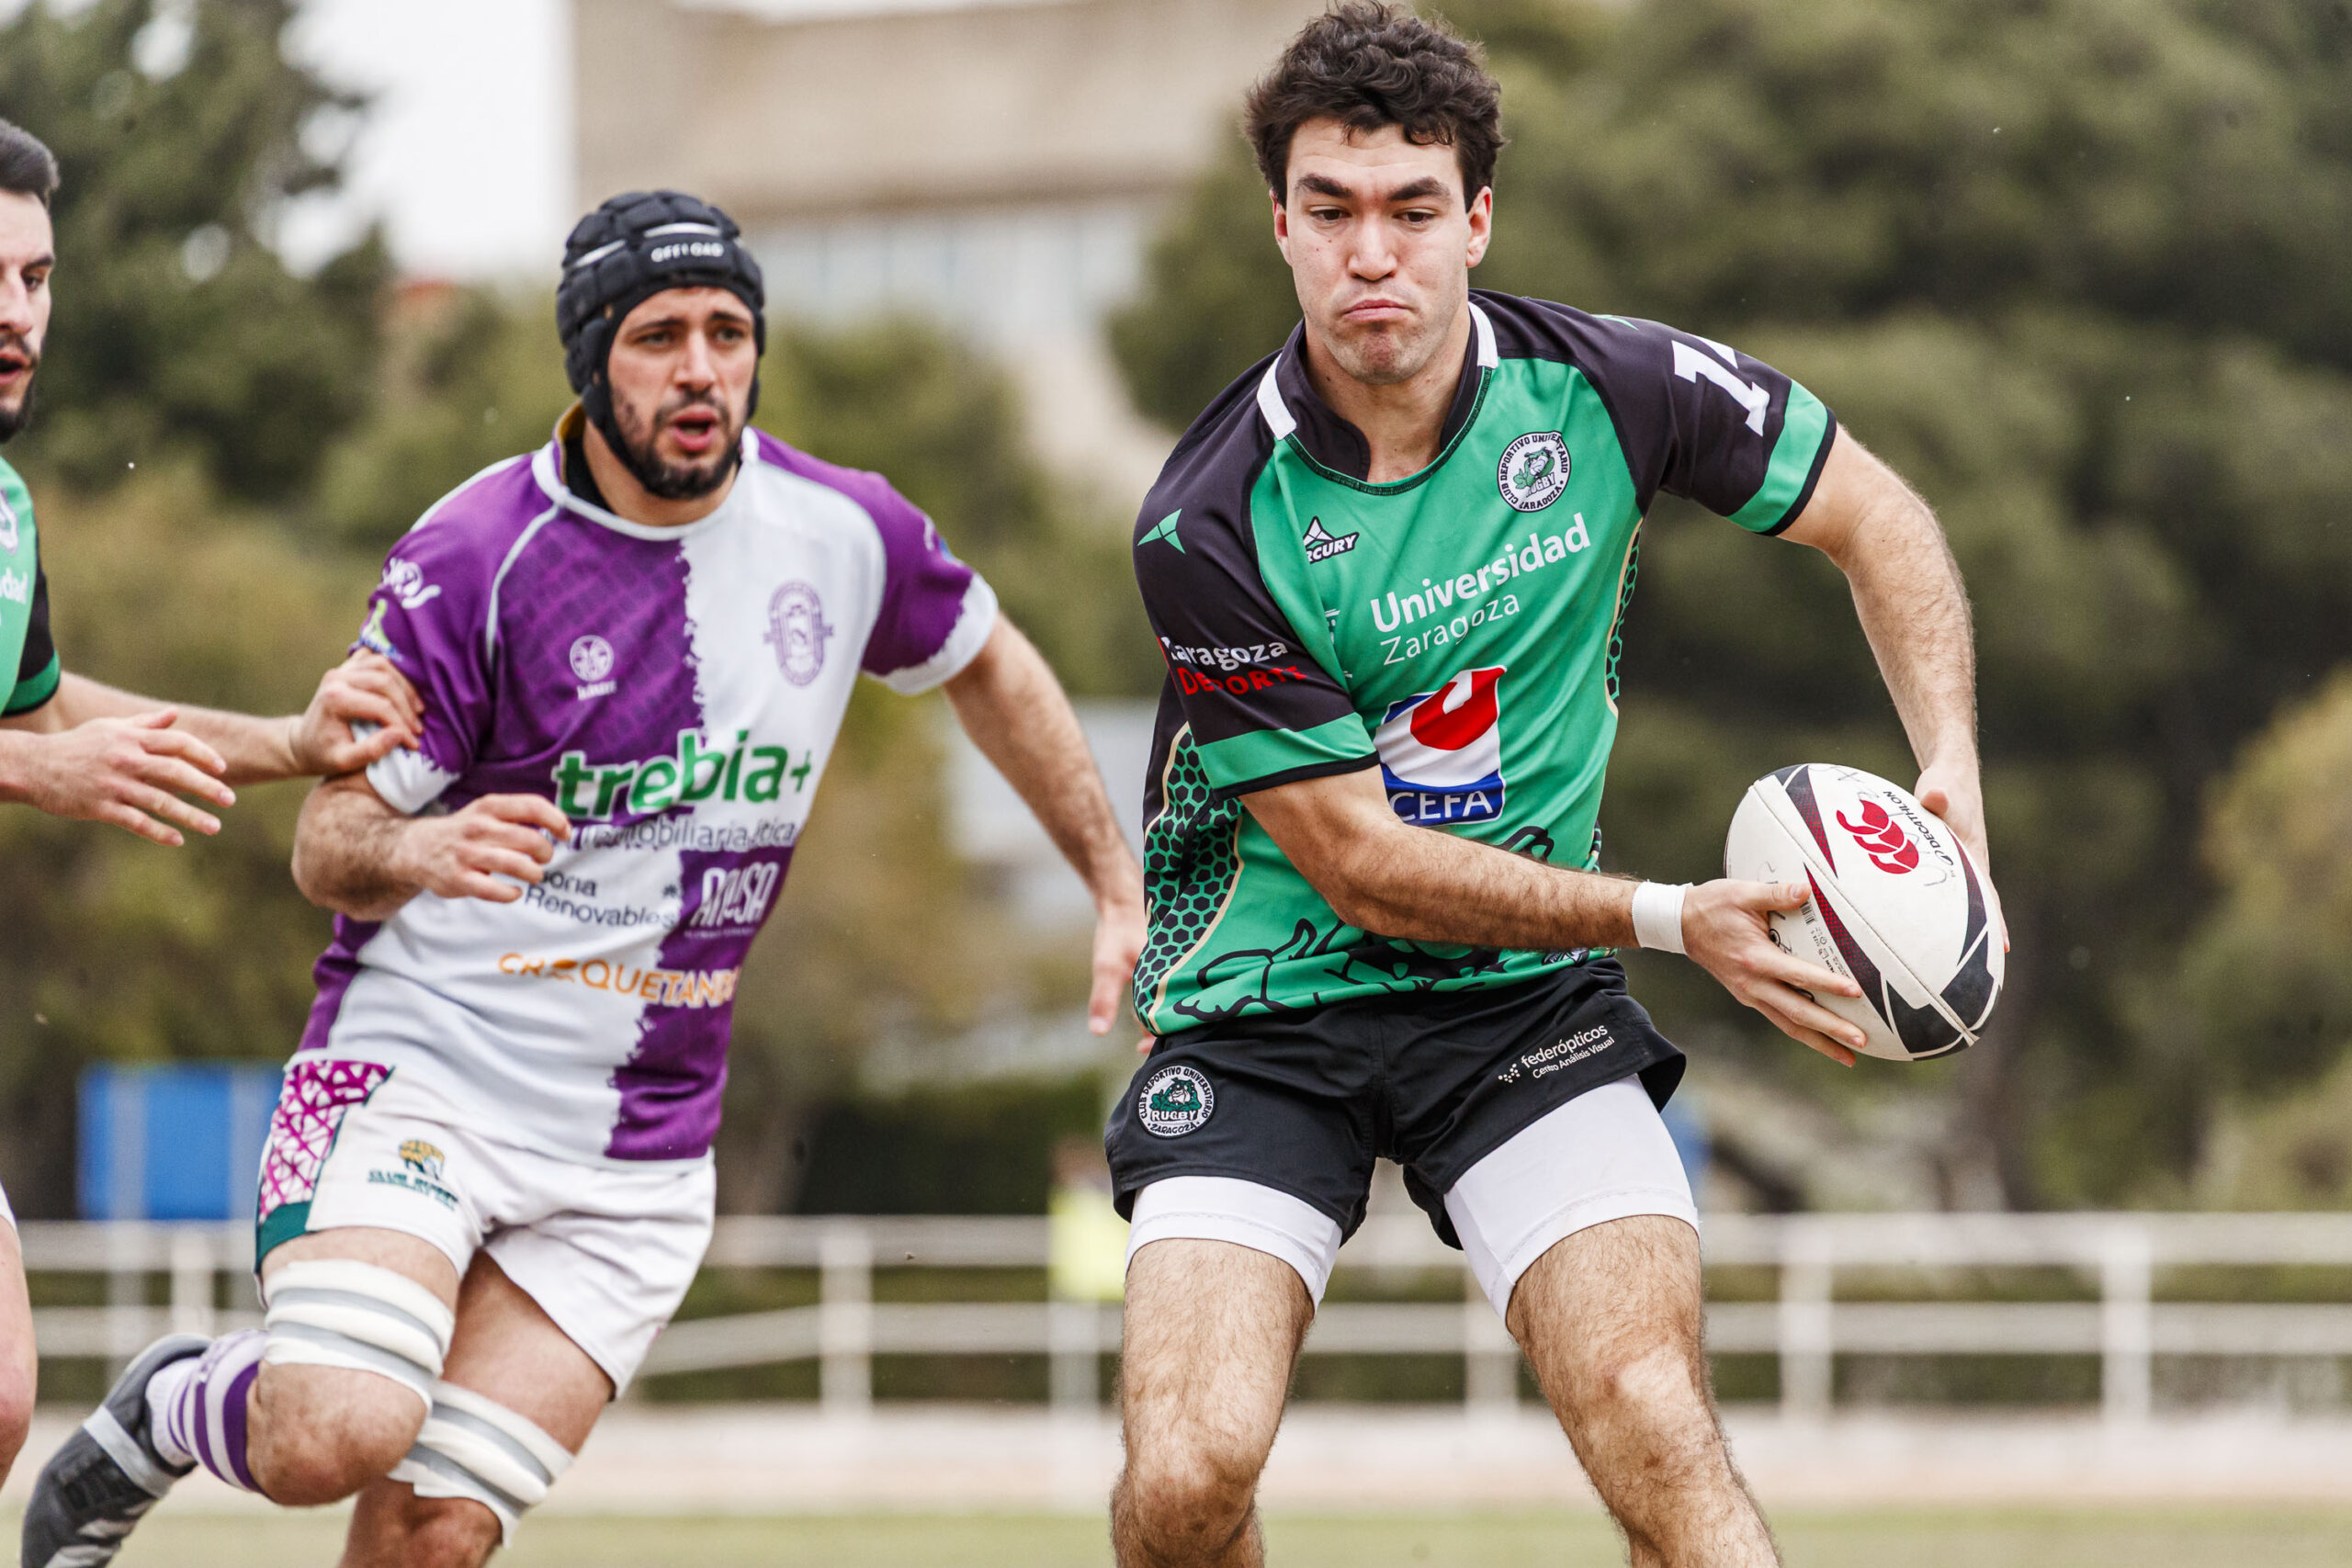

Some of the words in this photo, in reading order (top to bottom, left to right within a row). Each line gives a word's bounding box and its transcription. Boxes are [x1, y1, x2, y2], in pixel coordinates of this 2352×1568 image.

[1671, 333, 1770, 437] 1
[1500, 436, 1531, 481] DEPORTIVO
[1501, 483, 1519, 504] CLUB
[1306, 533, 1358, 563] RCURY
[1370, 512, 1591, 633] Universidad
[1380, 593, 1521, 666] Zaragoza
[553, 727, 812, 820] trebia+
[1388, 790, 1494, 822] CEFA
[1883, 790, 1941, 852] DECATHLON
[526, 885, 677, 929] Renovables
[1521, 1024, 1609, 1069] federópticos
[1532, 1062, 1560, 1079] Centro
[1559, 1049, 1591, 1069] Análisis
[1589, 1036, 1615, 1055] Visual
[1142, 1067, 1182, 1095] DEPORTIVO
[1139, 1097, 1148, 1119] CLUB
[1149, 1122, 1198, 1134] ZARAGOZA
[1150, 1110, 1199, 1121] RUGBY
